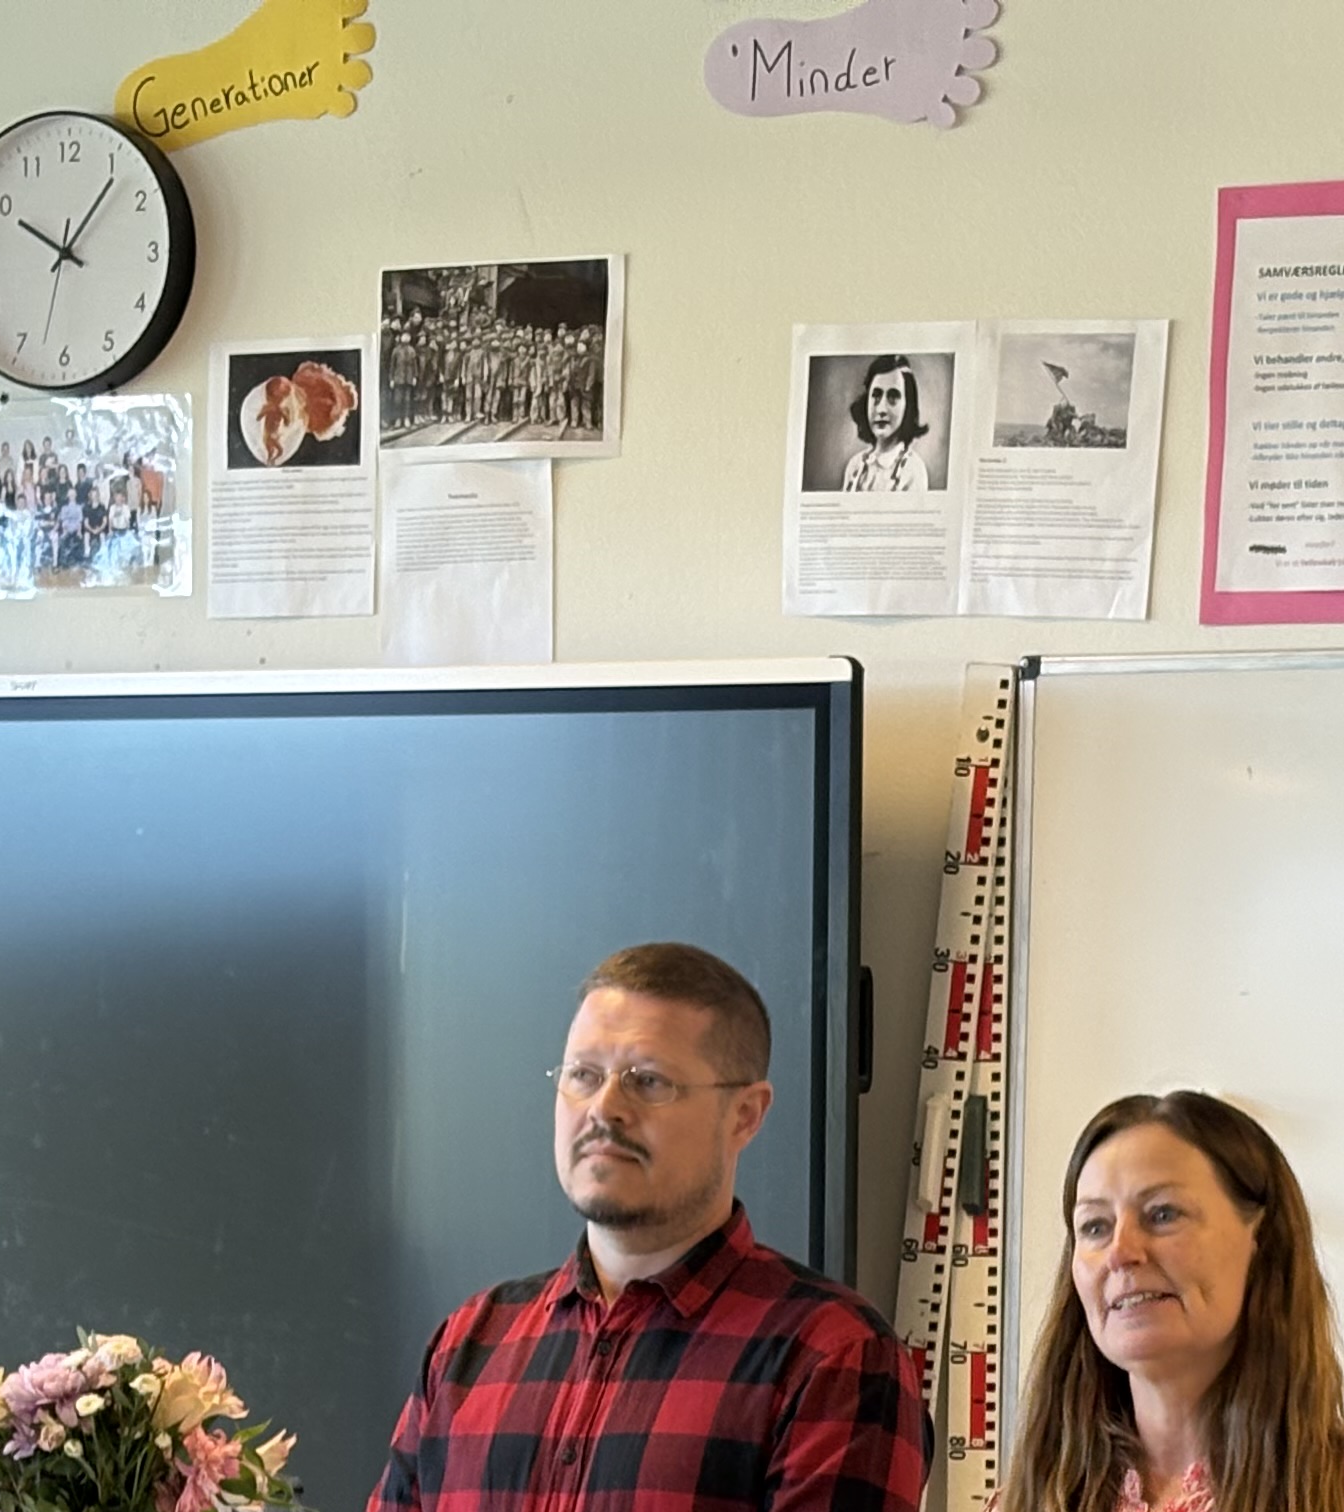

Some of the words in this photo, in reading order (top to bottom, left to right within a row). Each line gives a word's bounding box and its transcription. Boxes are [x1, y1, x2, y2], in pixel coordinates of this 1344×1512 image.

[751, 38, 896, 102] Minder
[133, 61, 320, 138] Generationer
[58, 141, 81, 163] 12
[108, 152, 115, 175] 1
[22, 156, 40, 178] 11
[135, 189, 148, 212] 2
[146, 241, 160, 263] 3
[134, 292, 146, 313] 4
[17, 332, 28, 354] 7
[102, 330, 115, 352] 5
[58, 344, 70, 367] 6
[954, 755, 972, 778] 10
[944, 850, 962, 876] 20
[932, 946, 951, 974] 30
[922, 1044, 940, 1071] 40
[902, 1238, 919, 1264] 60
[951, 1243, 969, 1268] 60
[951, 1339, 969, 1366] 70
[948, 1435, 967, 1462] 80
